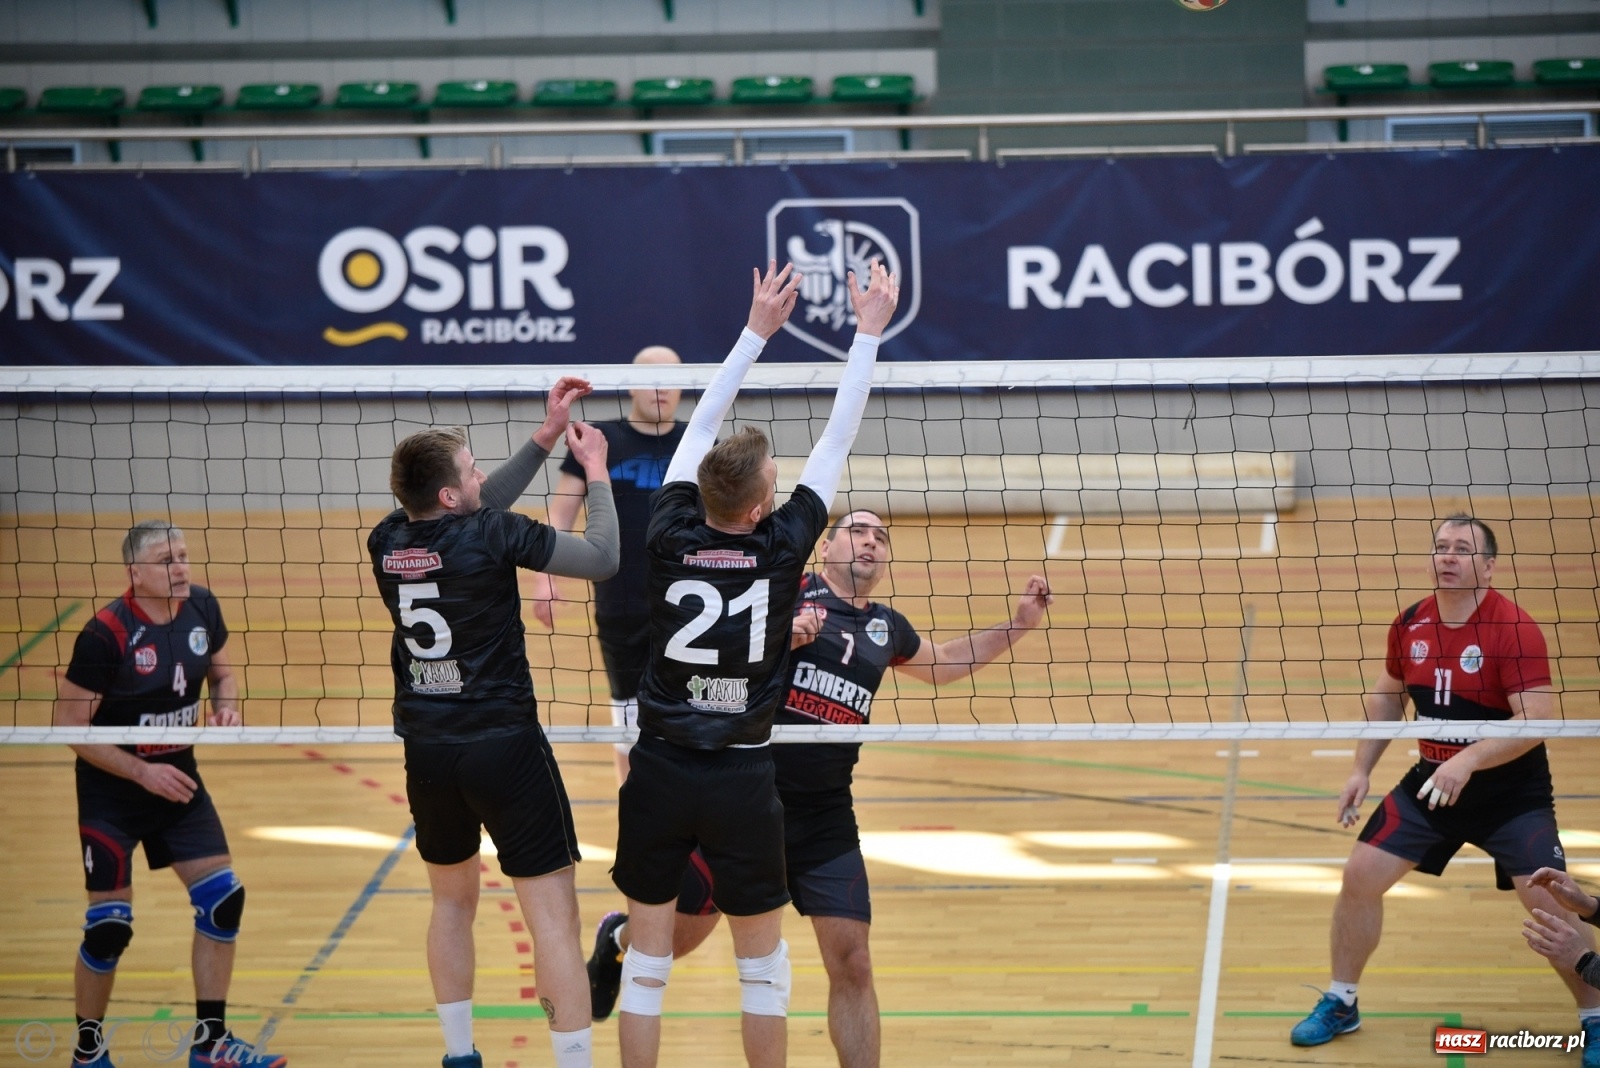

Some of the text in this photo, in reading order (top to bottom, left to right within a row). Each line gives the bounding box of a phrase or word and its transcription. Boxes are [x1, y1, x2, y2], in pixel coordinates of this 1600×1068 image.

[1007, 217, 1463, 309] RACIBÓRZ
[0, 256, 124, 320] RZ
[421, 311, 576, 343] RACIBÓRZ
[689, 558, 751, 569] PIWIARNIA
[398, 582, 453, 659] 5
[664, 578, 771, 665] 21
[841, 630, 856, 665] 7
[172, 662, 187, 697] 4
[420, 660, 461, 684] KAKTUS
[706, 677, 748, 701] KAKTUS
[1434, 668, 1452, 706] 11
[85, 846, 94, 874] 4
